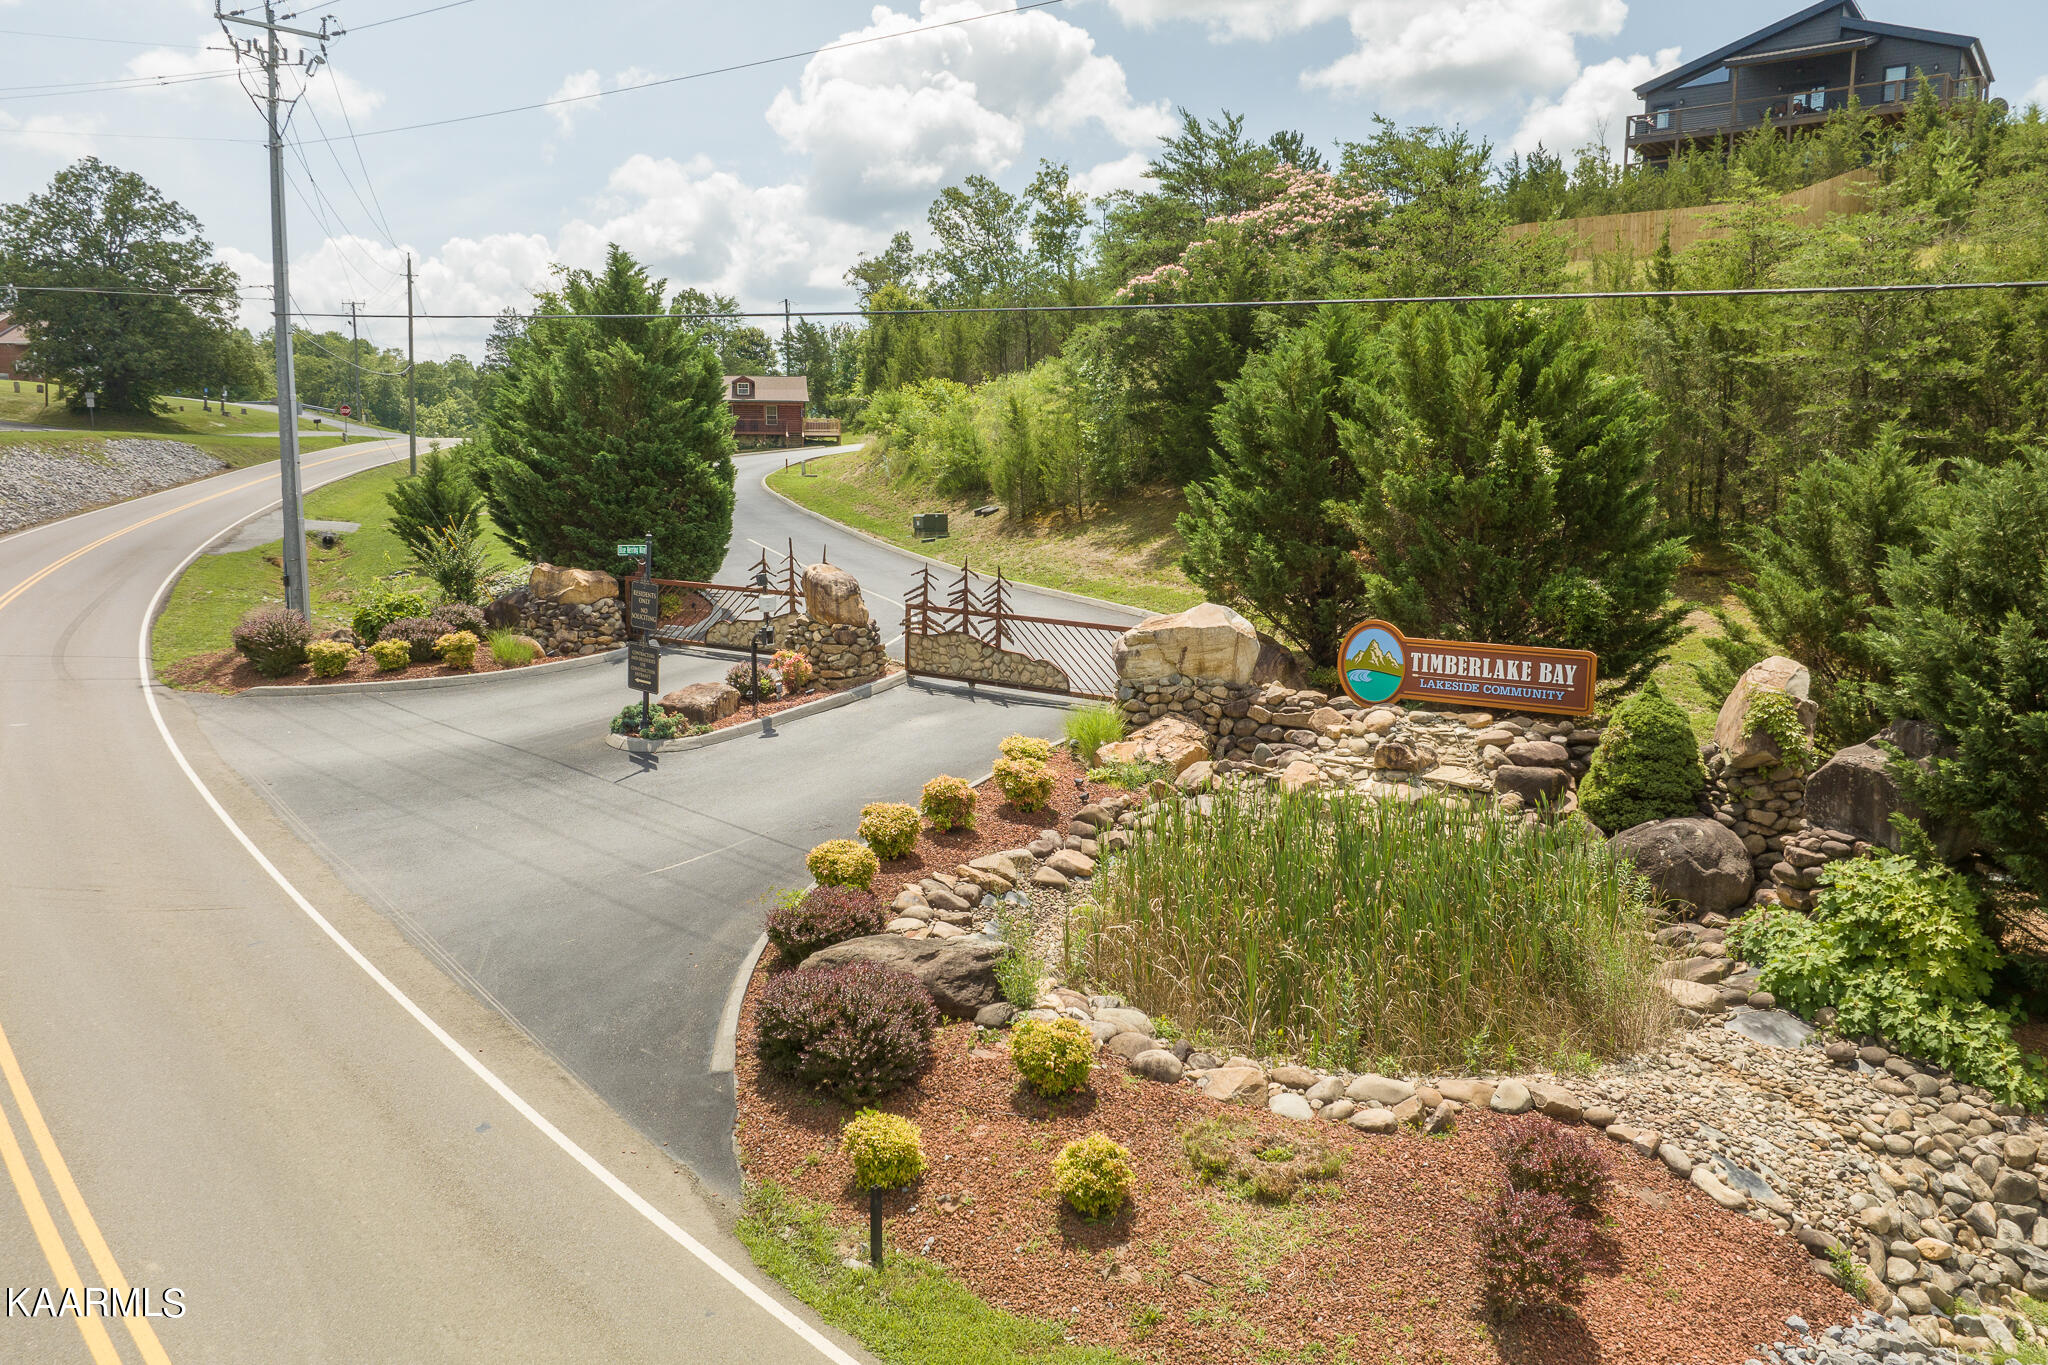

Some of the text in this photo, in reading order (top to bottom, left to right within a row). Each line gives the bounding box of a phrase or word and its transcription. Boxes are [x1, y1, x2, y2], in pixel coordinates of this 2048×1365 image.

[633, 589, 656, 599] RESIDENTS
[638, 597, 650, 605] ONLY
[632, 612, 656, 622] SOLICITING
[1411, 652, 1577, 686] TIMBERLAKE BAY
[1420, 679, 1565, 701] LAKESIDE COMMUNITY
